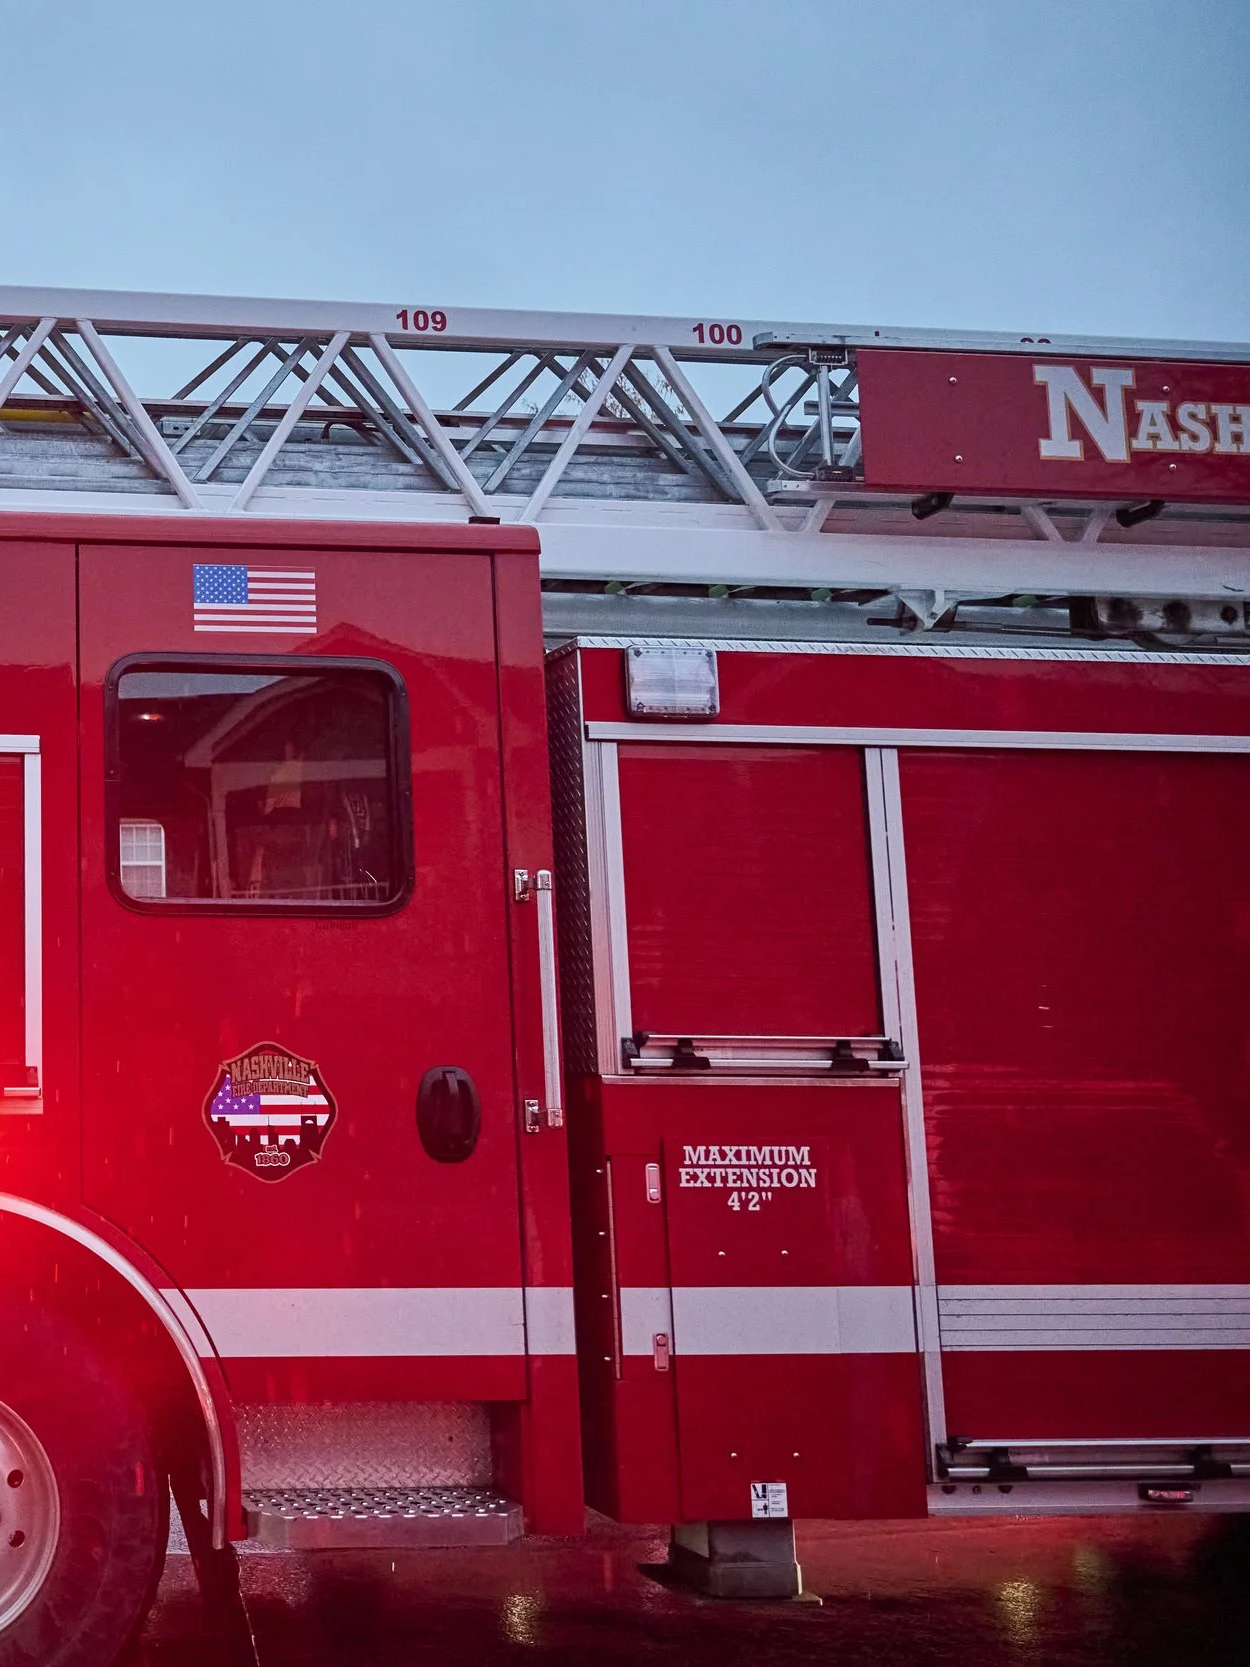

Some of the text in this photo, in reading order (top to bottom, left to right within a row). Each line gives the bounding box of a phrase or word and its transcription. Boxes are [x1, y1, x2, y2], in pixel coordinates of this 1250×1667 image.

[396, 309, 447, 332] 109
[692, 323, 743, 345] 100
[231, 1055, 310, 1084] NASHVILLE
[232, 1081, 309, 1098] FIRE DEPARTMENT
[255, 1152, 290, 1167] 1860
[683, 1145, 811, 1165] MAXIMUM
[679, 1168, 817, 1188] EXTENSION
[727, 1191, 772, 1211] 4'2"
